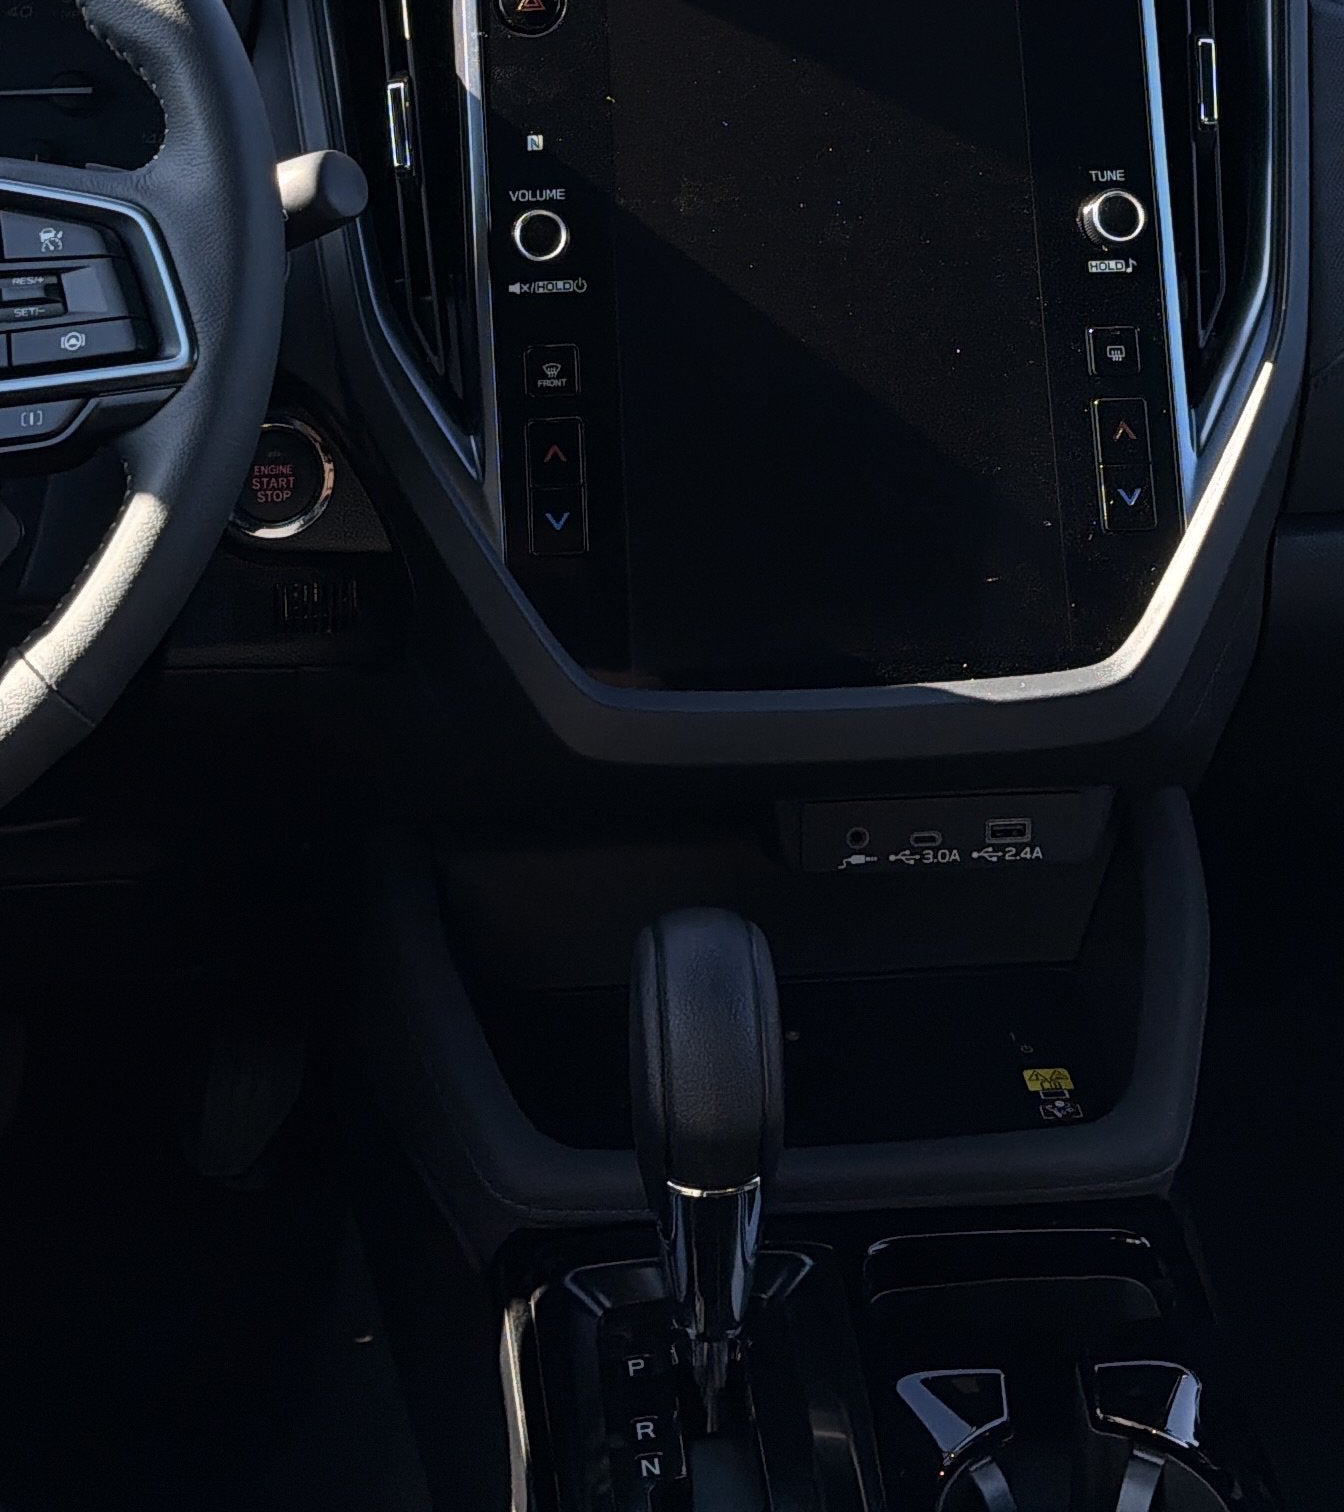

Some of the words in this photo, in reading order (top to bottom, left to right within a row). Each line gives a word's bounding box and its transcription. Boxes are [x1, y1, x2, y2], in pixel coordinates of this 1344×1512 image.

[1089, 170, 1126, 182] TUNE
[509, 188, 566, 202] VOLUME
[1088, 260, 1126, 273] HOLD
[535, 280, 573, 293] HOLD
[537, 378, 567, 389] FRONT
[254, 464, 293, 476] ENGINE
[252, 476, 296, 490] START
[257, 490, 292, 503] STOP
[921, 849, 961, 864] 3.0A
[1004, 846, 1044, 861] 2.4A
[627, 1358, 645, 1377] P
[636, 1421, 657, 1441] R
[640, 1457, 661, 1477] N
